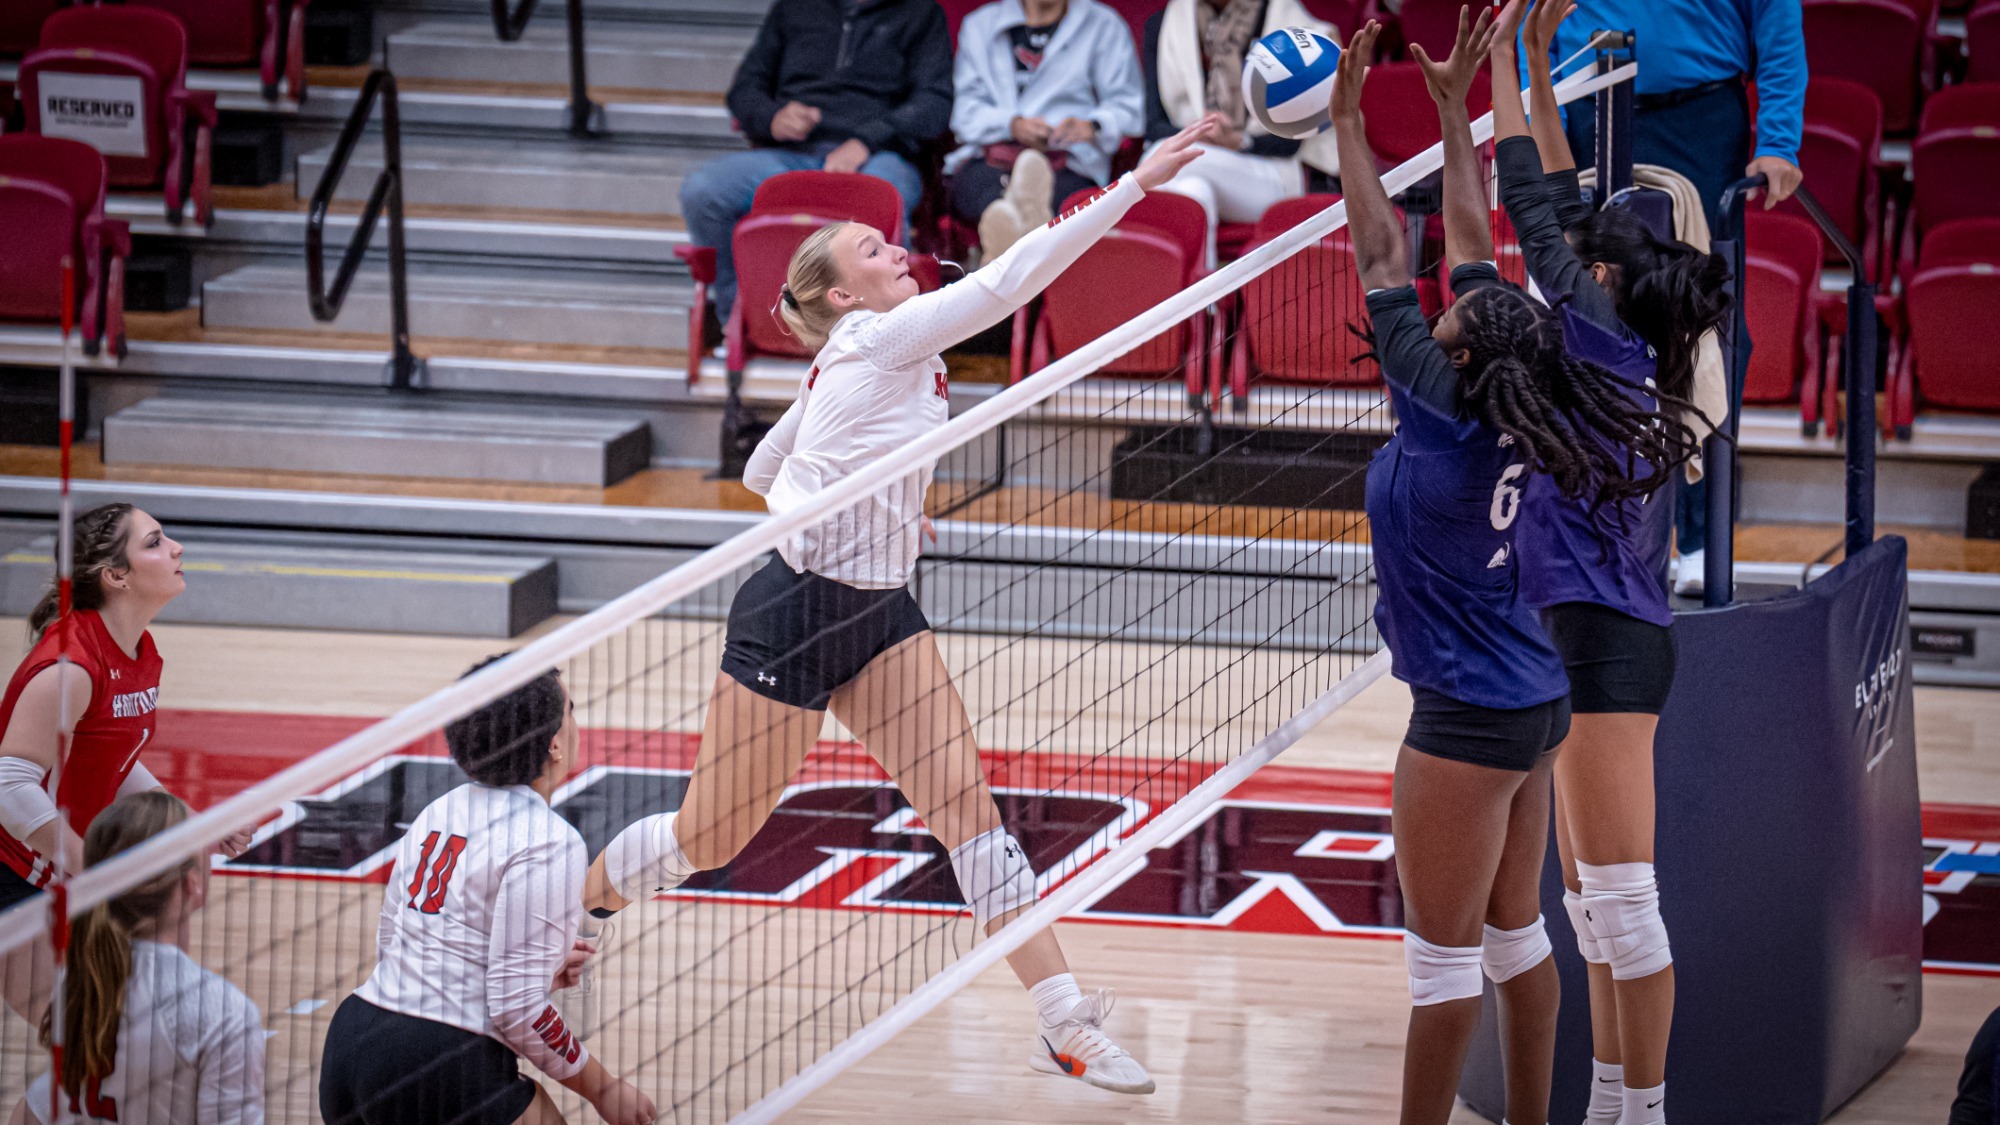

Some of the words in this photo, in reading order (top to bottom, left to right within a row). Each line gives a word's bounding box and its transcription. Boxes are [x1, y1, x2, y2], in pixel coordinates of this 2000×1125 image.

[47, 96, 134, 119] RESERVED
[1489, 464, 1525, 530] 6
[407, 830, 468, 914] 10
